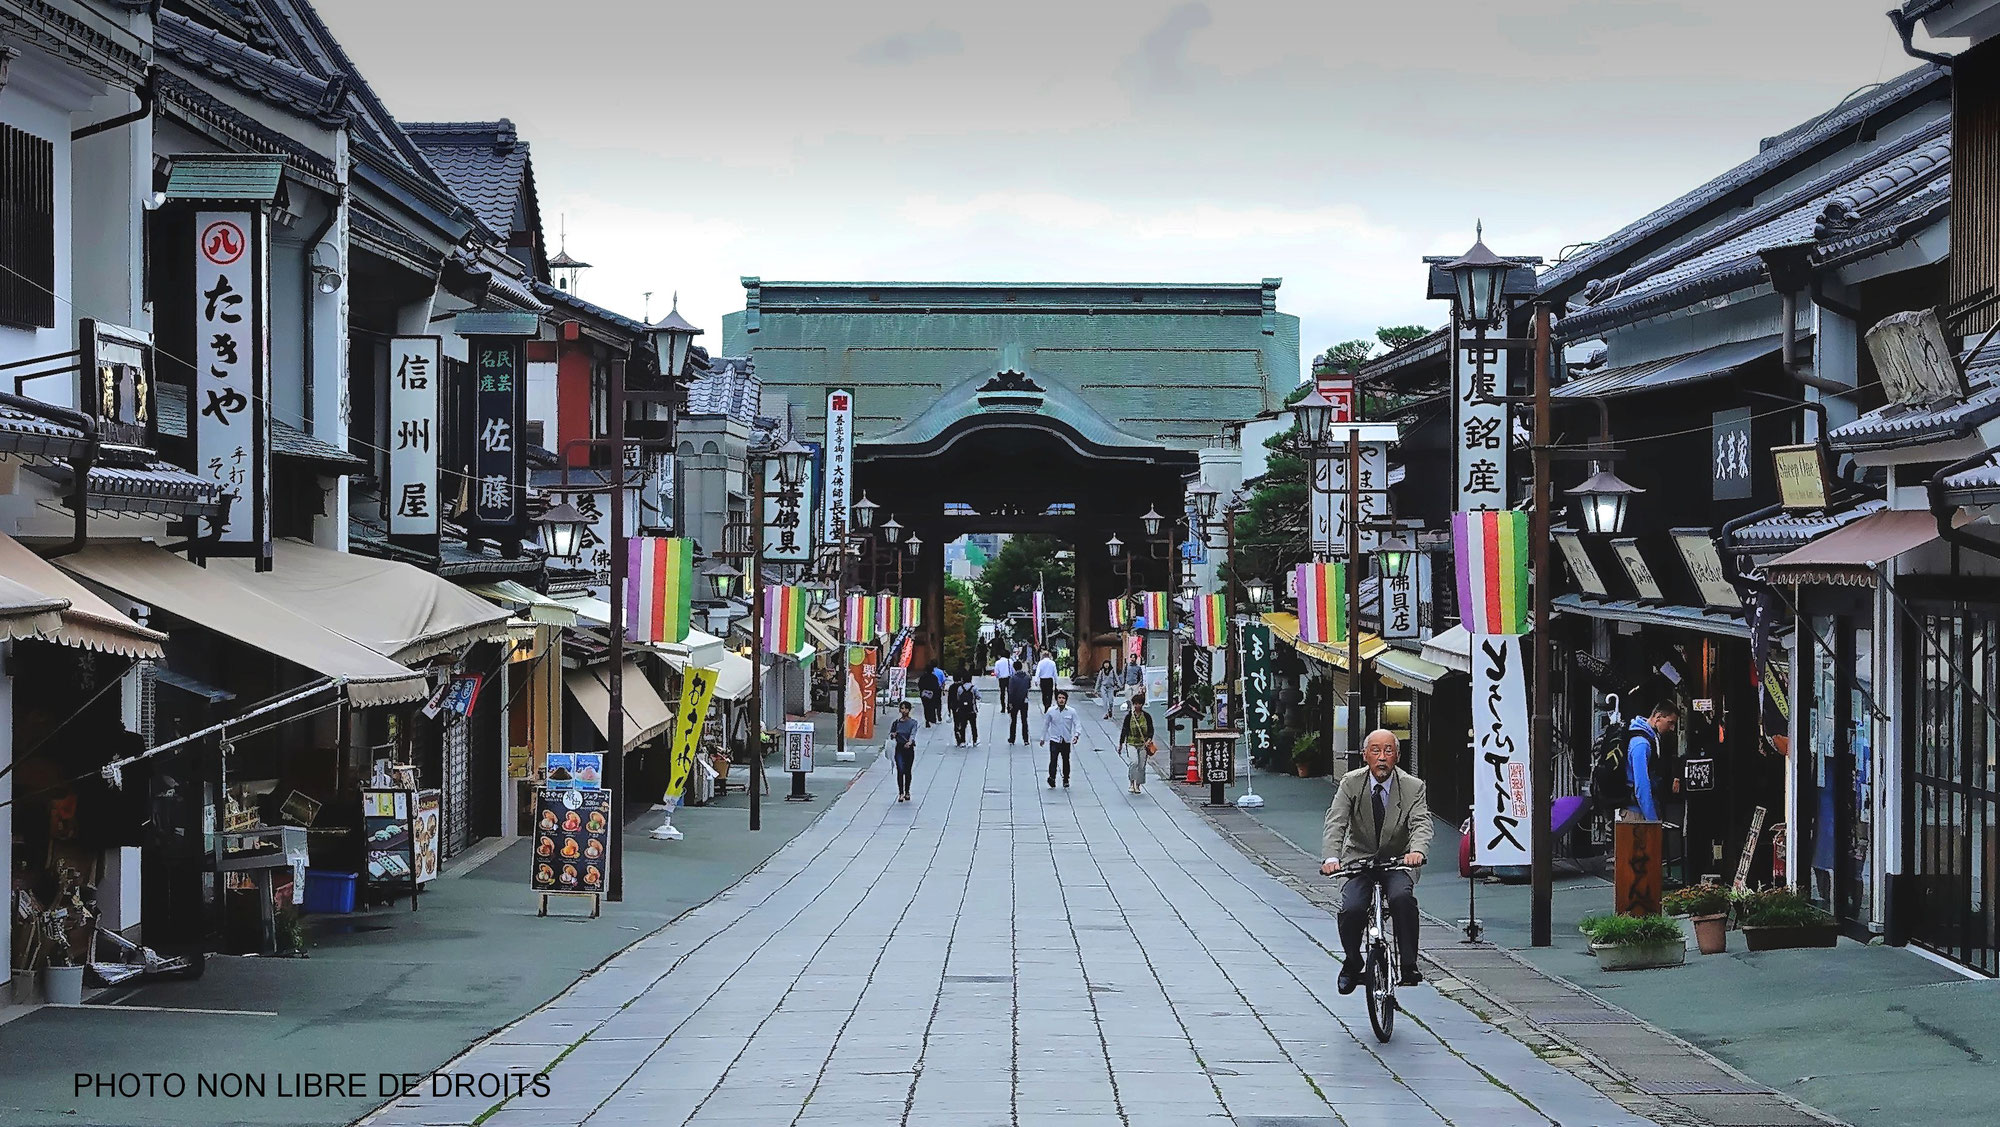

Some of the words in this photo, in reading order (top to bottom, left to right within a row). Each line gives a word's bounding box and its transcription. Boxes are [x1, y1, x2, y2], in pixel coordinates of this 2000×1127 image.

[202, 274, 248, 426] たきや
[480, 350, 496, 392] 名産
[497, 350, 513, 392] 民芸
[396, 353, 430, 518] 信州屋
[480, 418, 513, 509] 佐藤
